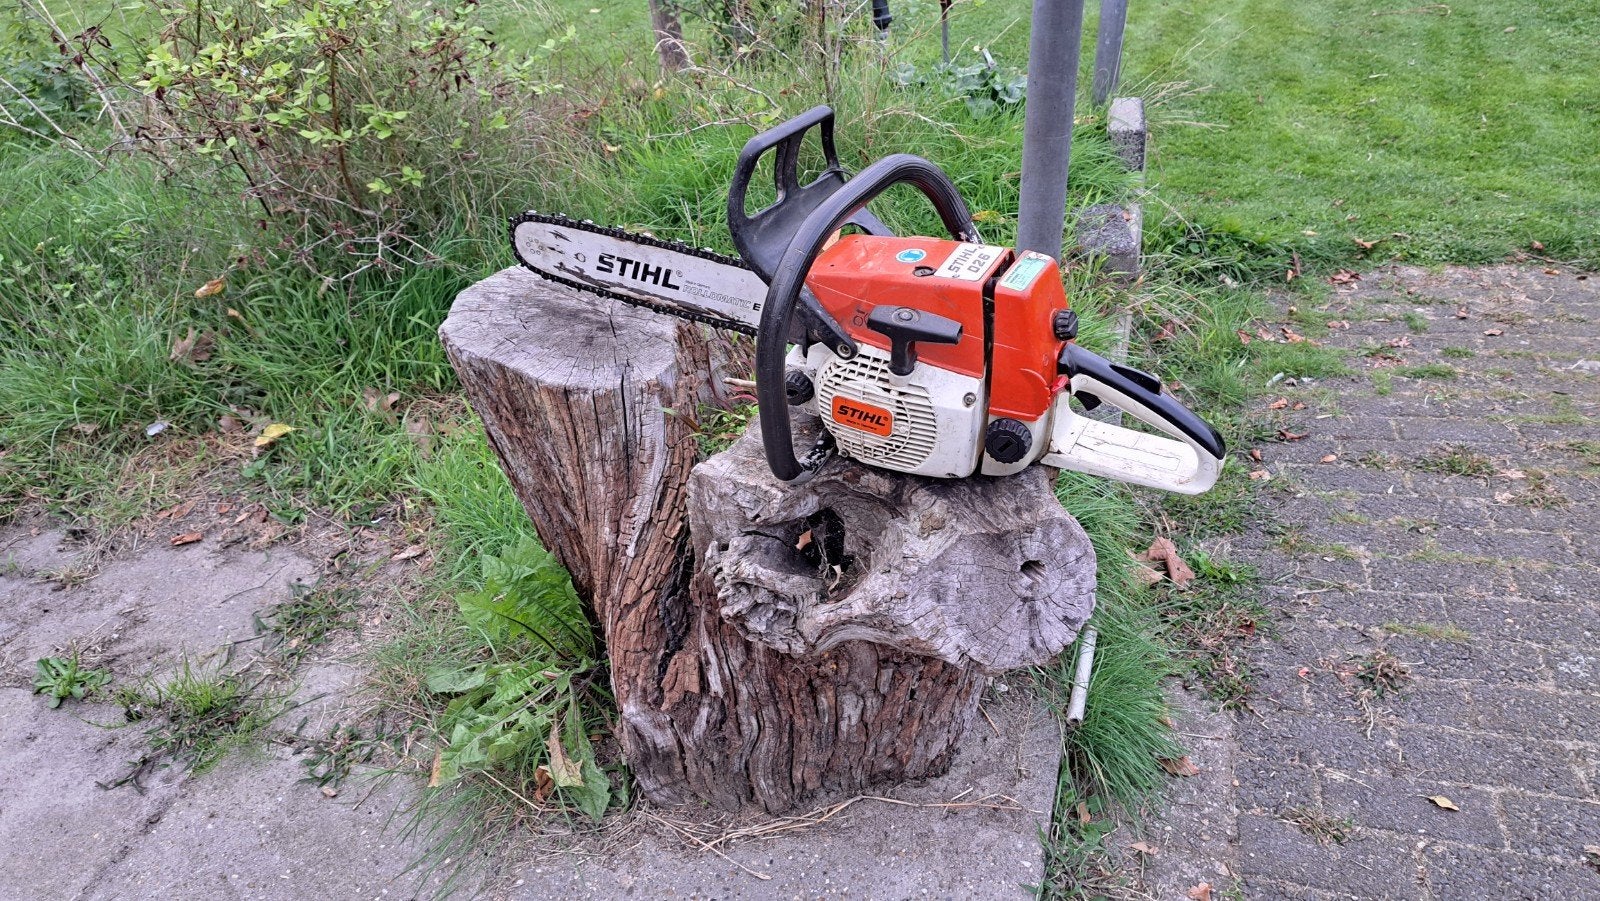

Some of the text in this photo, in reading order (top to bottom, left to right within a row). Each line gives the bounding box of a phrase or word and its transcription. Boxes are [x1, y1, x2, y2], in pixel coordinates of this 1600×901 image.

[596, 252, 680, 291] STIHL
[948, 248, 978, 273] STIHL
[967, 253, 990, 273] 026
[682, 284, 762, 312] ROLLOMATIC E
[837, 404, 886, 427] STIHL
